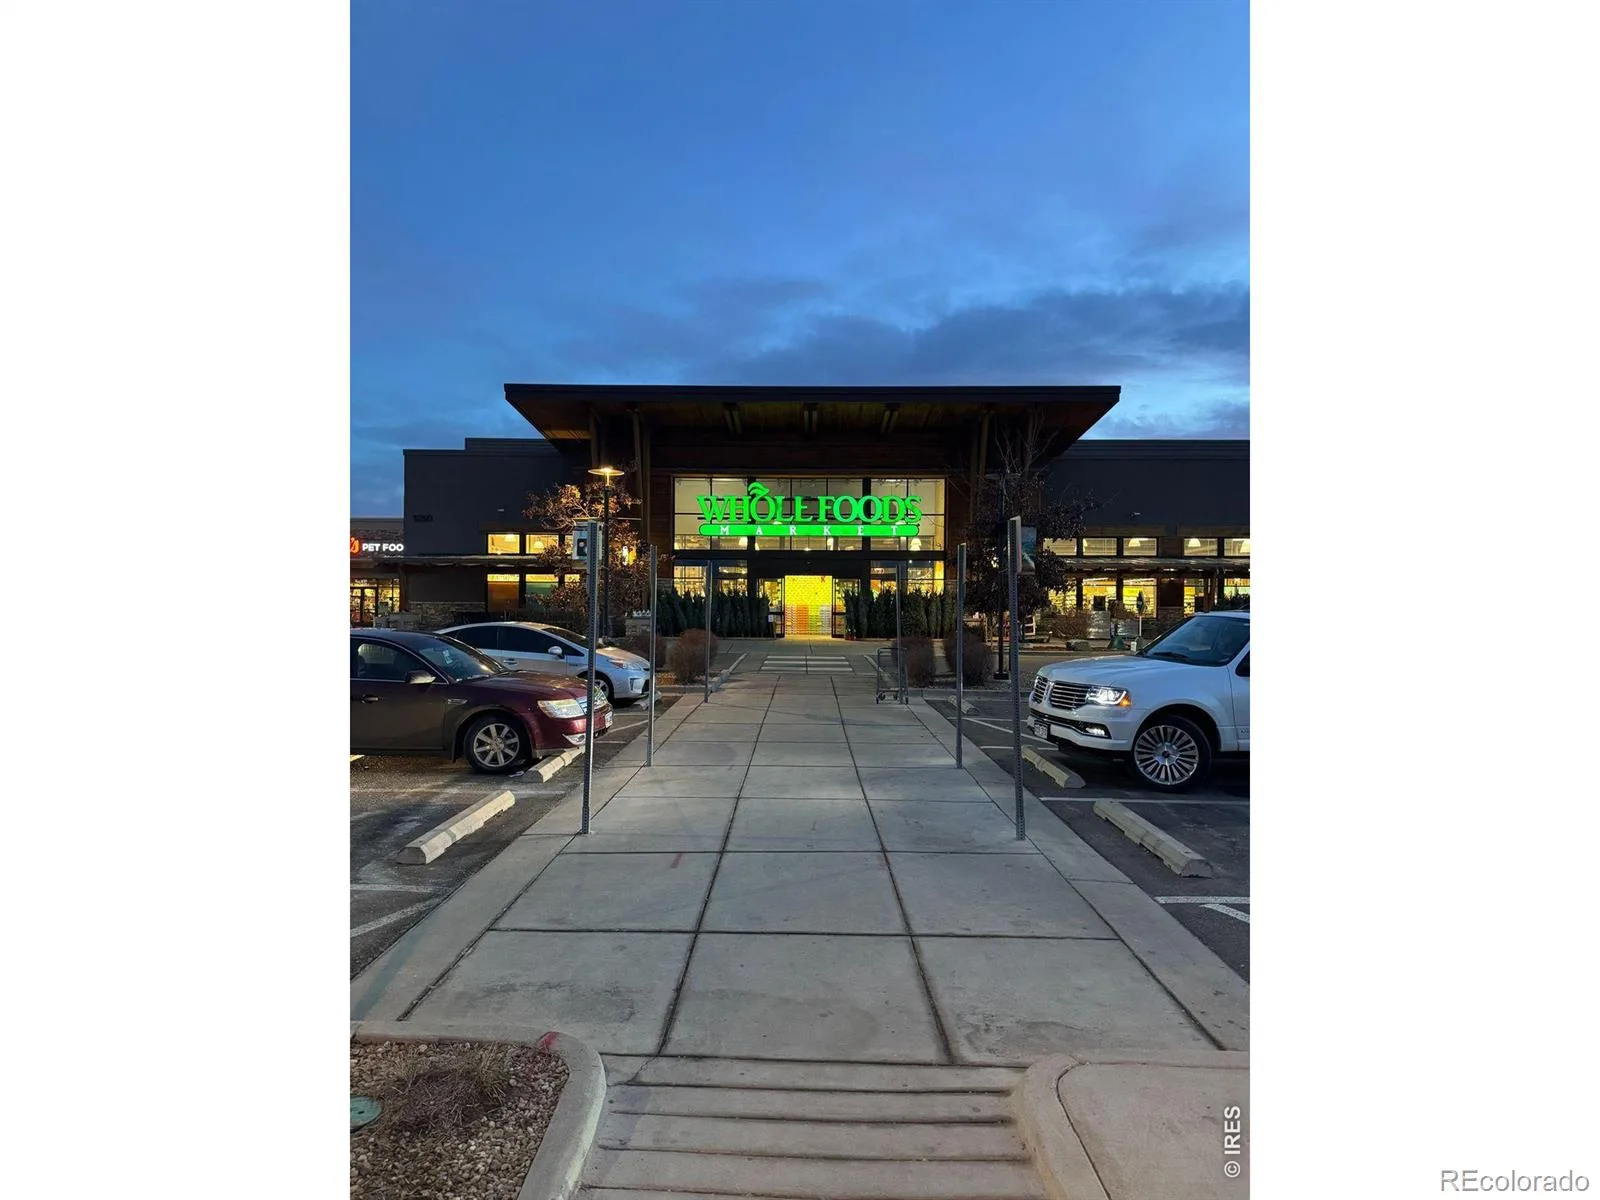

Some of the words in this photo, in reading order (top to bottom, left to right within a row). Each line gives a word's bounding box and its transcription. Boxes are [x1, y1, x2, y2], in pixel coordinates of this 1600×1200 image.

[696, 482, 814, 522] WHOLE
[817, 495, 922, 523] FOODS
[720, 525, 898, 536] MARKET
[362, 543, 381, 552] PET
